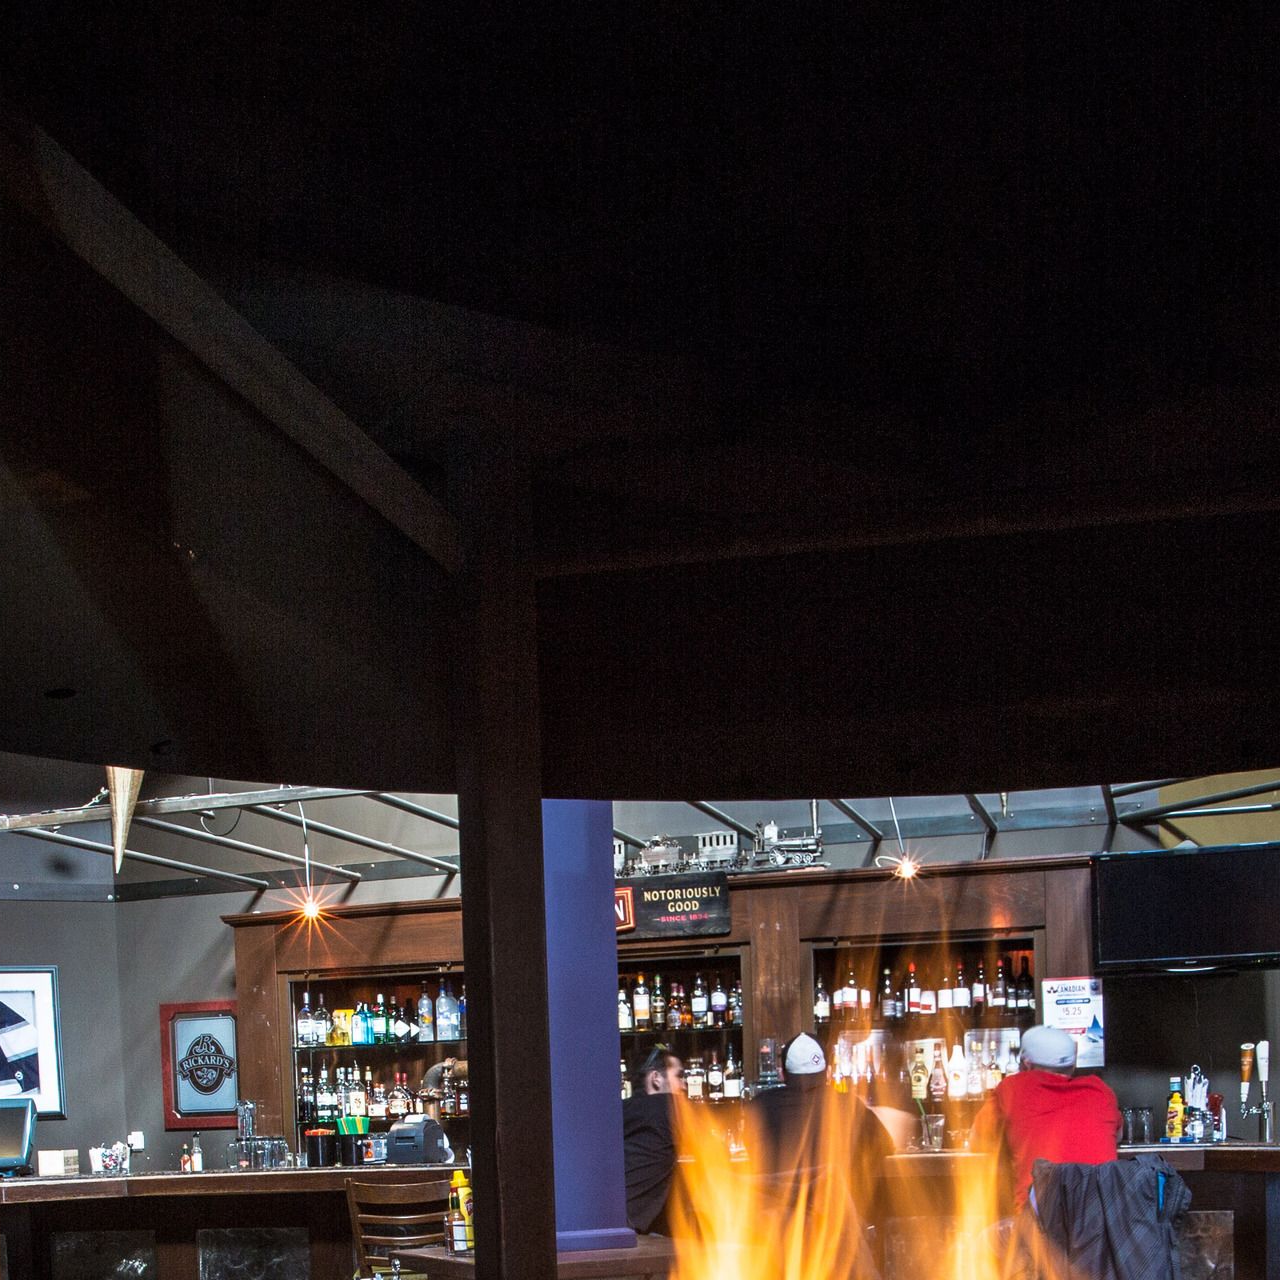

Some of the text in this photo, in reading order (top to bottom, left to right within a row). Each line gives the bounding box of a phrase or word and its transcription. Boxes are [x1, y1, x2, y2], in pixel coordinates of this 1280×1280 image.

[643, 886, 720, 901] NOTORIOUSLY
[667, 900, 699, 912] GOOD
[660, 913, 687, 922] SINCE
[182, 1055, 230, 1070] RICKARD'S
